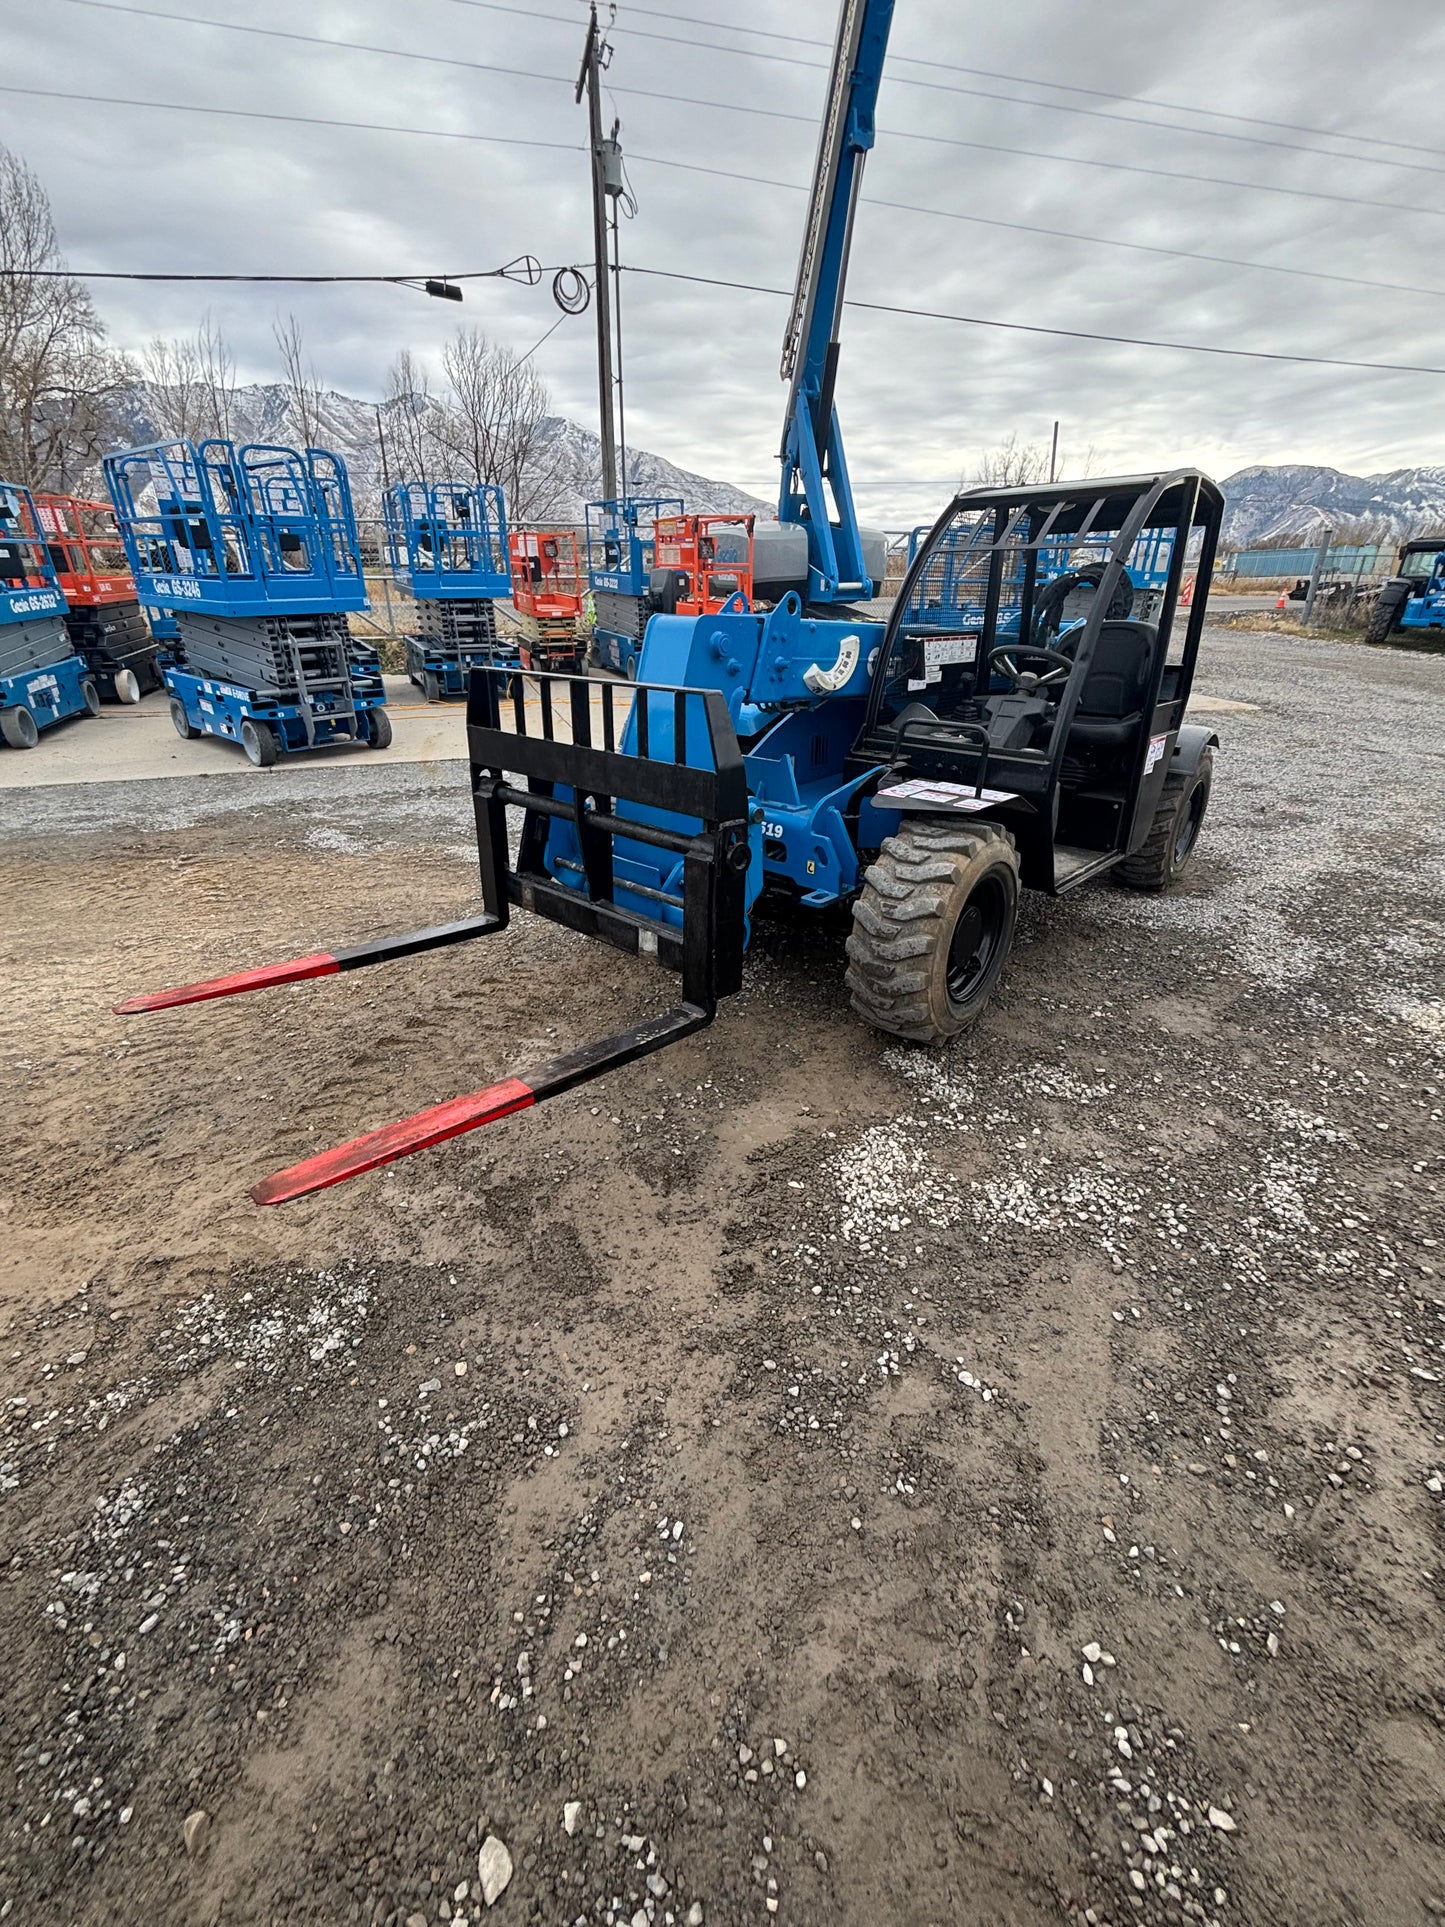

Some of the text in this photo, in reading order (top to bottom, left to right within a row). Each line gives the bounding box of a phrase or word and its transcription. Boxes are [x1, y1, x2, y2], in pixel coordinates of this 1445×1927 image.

[153, 578, 171, 595] Genie
[171, 579, 201, 598] GS-3246
[10, 593, 57, 614] Genie GS-2632
